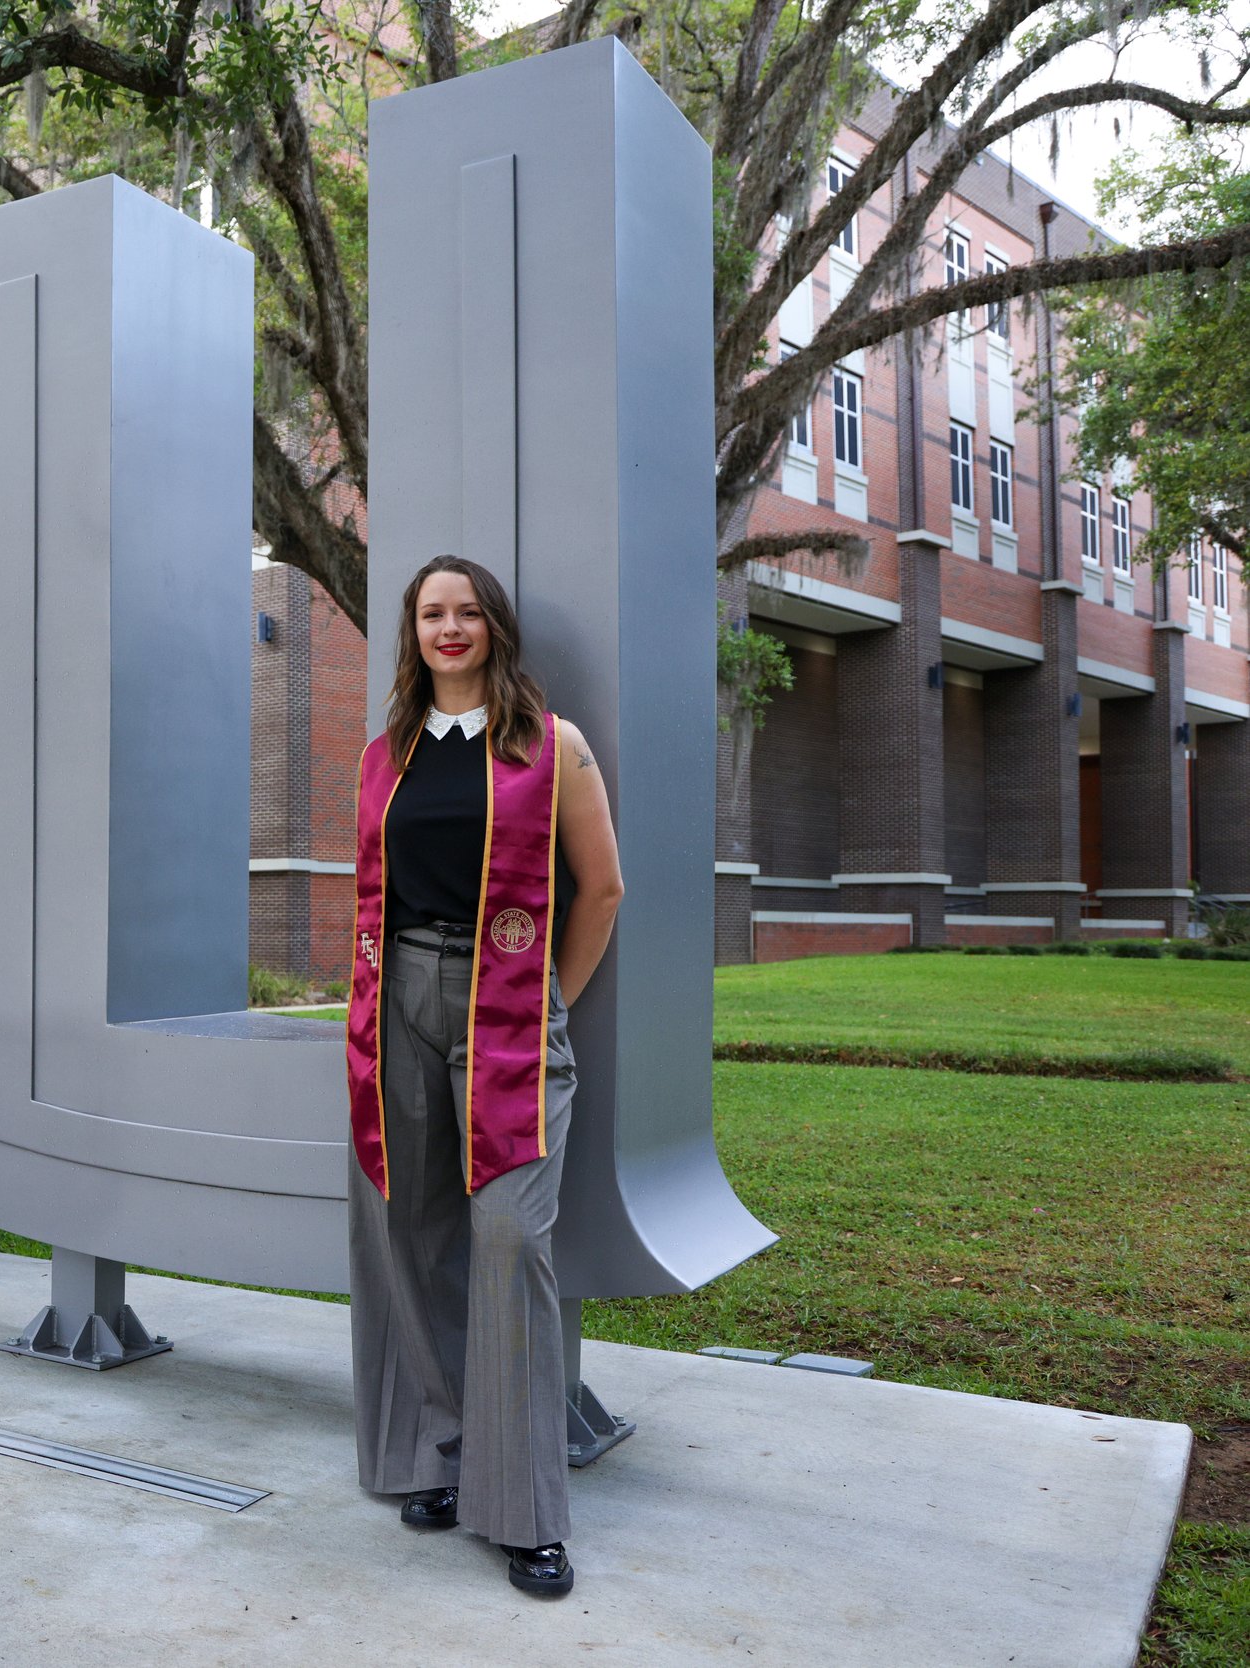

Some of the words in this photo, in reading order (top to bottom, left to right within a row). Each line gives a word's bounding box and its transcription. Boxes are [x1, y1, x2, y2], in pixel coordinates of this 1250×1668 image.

[494, 917, 503, 940] FLORIDA
[520, 914, 532, 944] UNIVERSITY
[360, 932, 378, 967] FSU
